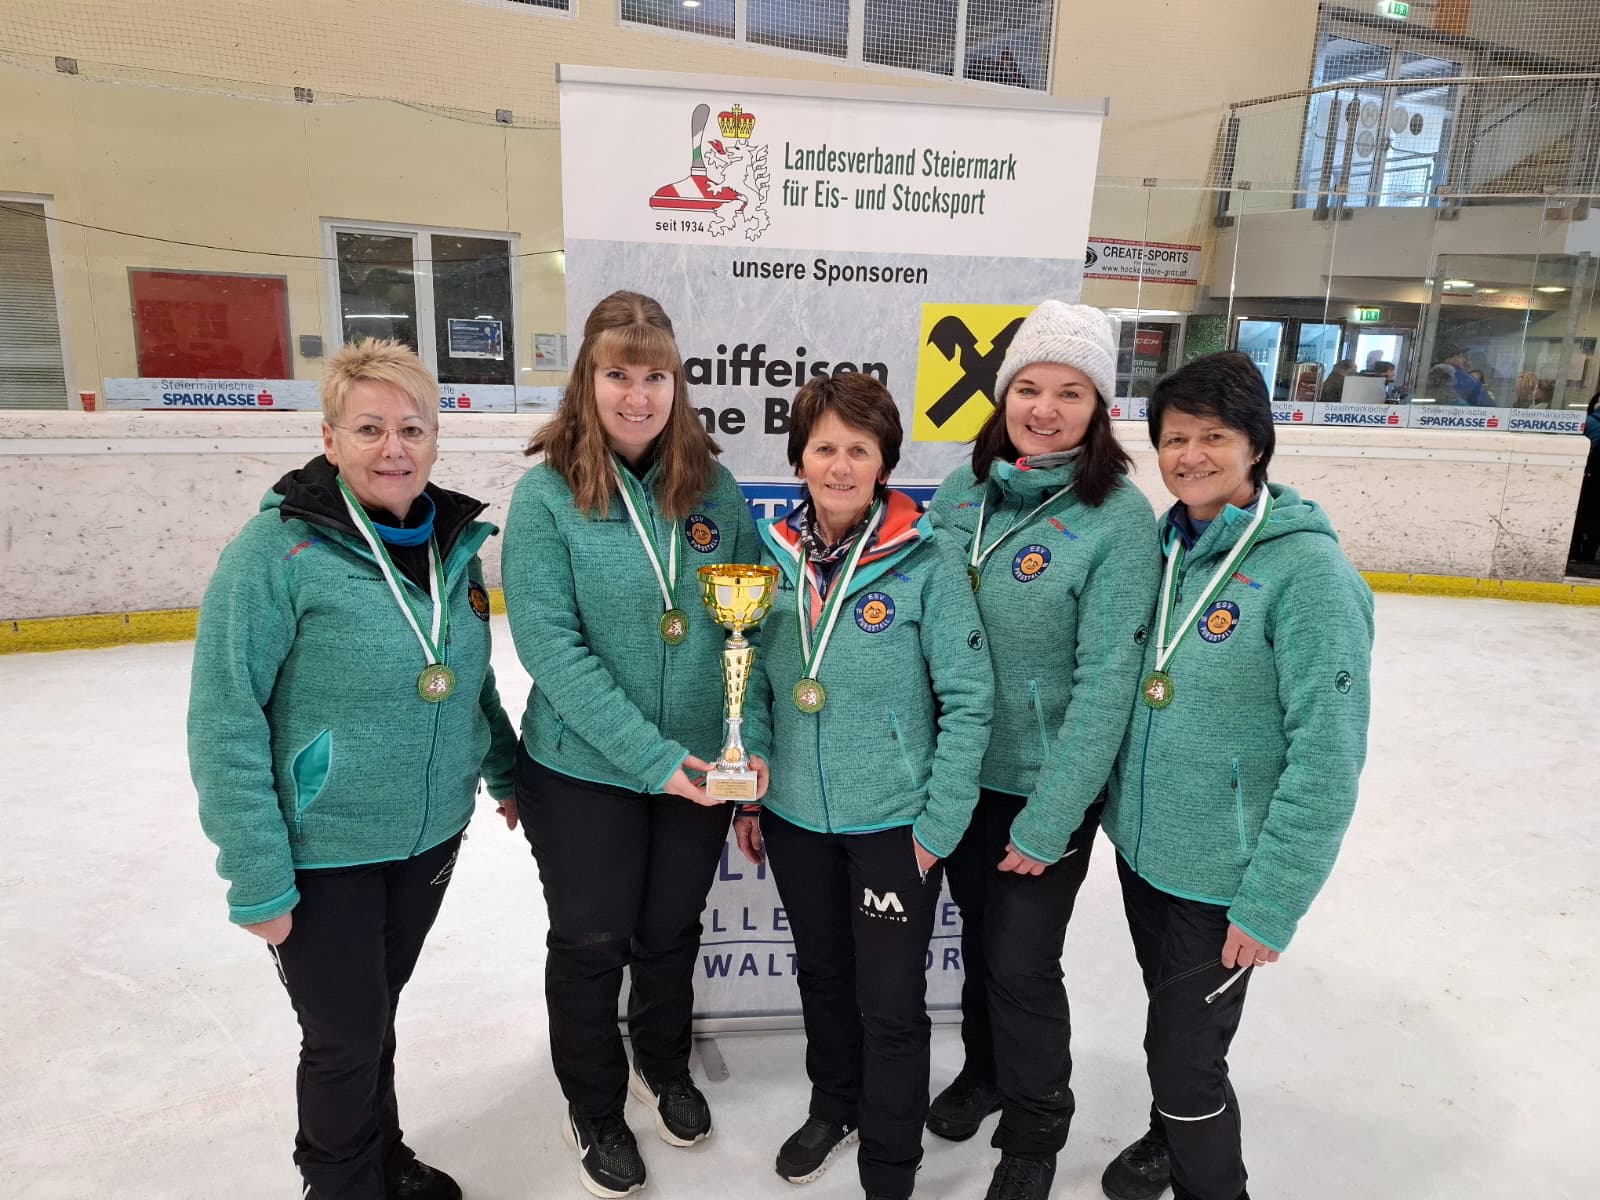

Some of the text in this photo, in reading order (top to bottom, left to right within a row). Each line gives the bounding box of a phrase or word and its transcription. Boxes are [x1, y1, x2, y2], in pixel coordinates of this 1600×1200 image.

[784, 142, 1017, 180] Landesverband Steiermark
[783, 179, 986, 219] für Eis- und Stocksport
[655, 219, 704, 232] seit 1934
[1103, 246, 1189, 263] CREATE-SPORTS
[733, 259, 928, 286] unsere Sponsoren
[683, 343, 888, 388] aiffeisn
[161, 380, 254, 391] Steiermärkische
[163, 393, 256, 406] SPARKASSE
[1324, 413, 1387, 425] SPARKASSE
[1420, 416, 1485, 428] SPARKASSE
[1510, 419, 1580, 431] SPARKASSE
